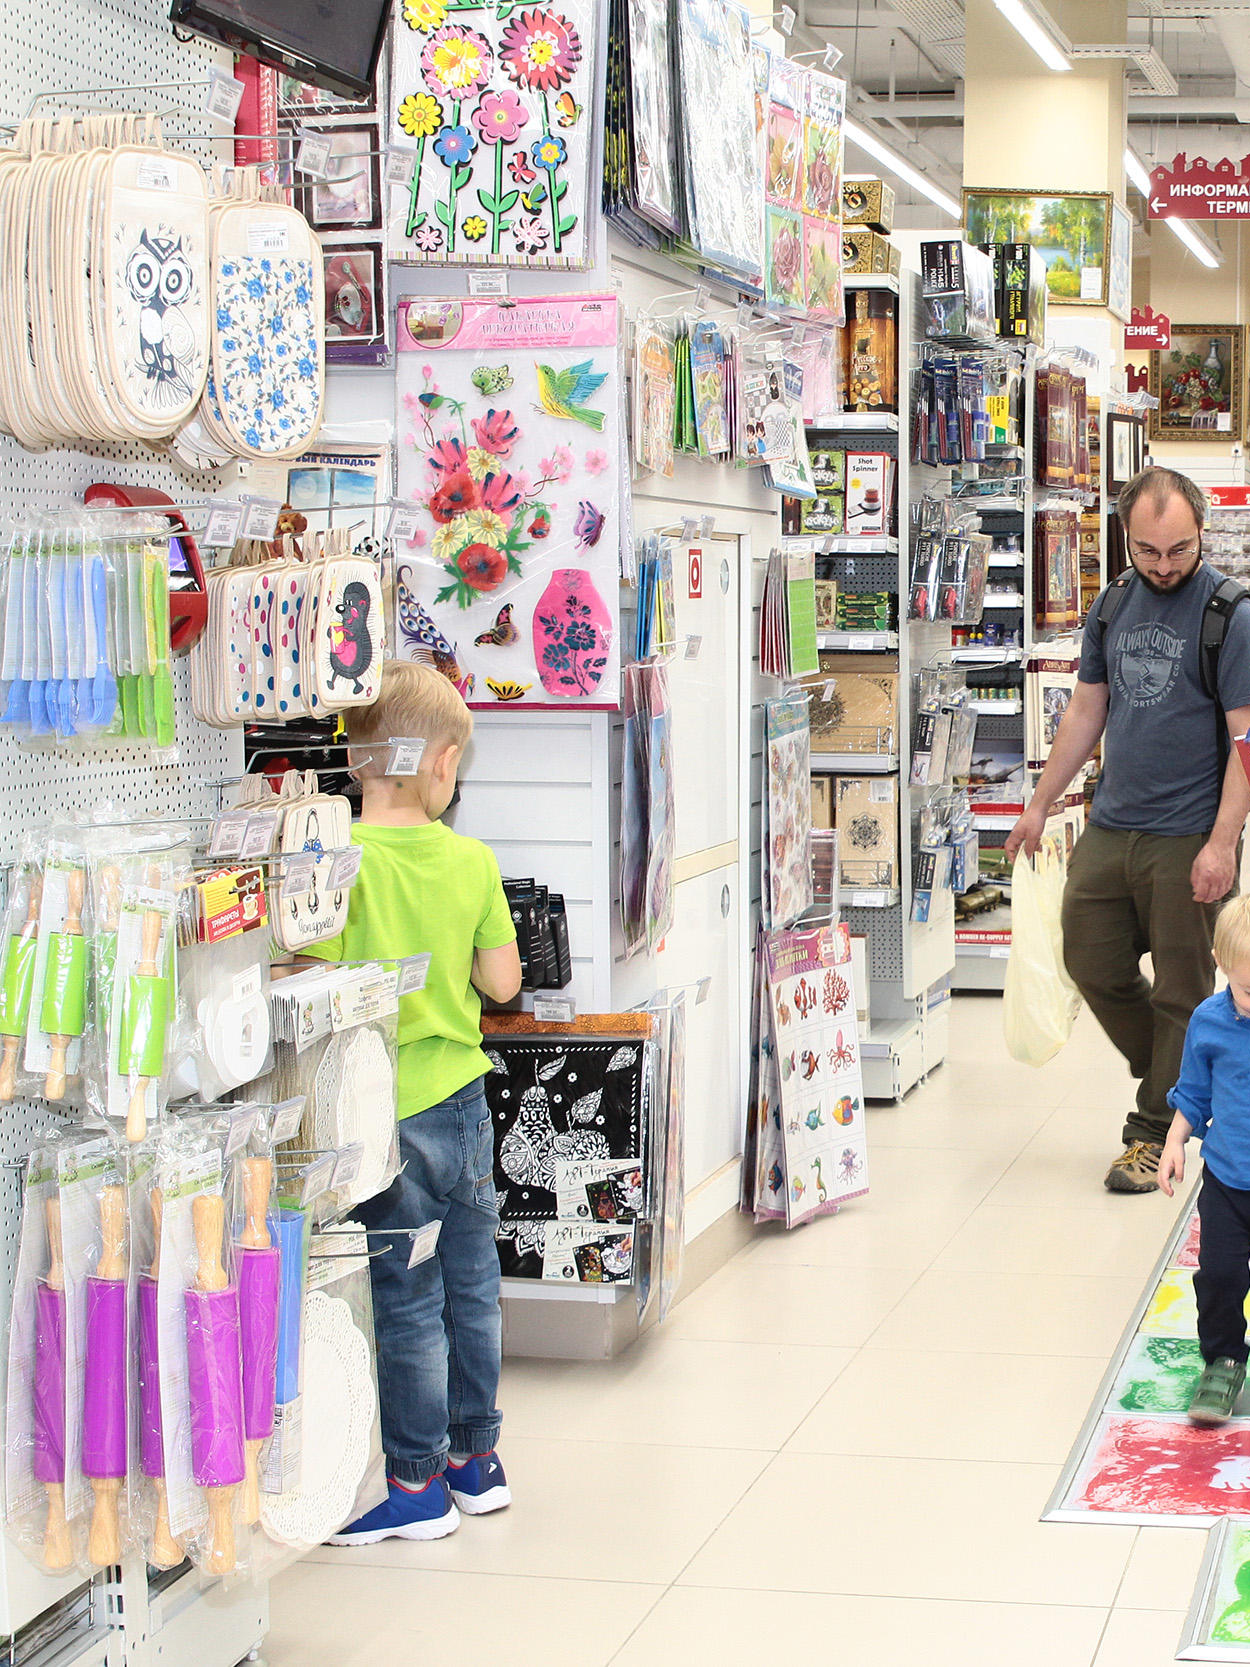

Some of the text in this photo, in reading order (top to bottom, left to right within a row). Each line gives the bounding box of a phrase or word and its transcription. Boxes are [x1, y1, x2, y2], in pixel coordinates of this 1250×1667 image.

[1124, 326, 1159, 336] ЕНИЕ
[320, 457, 376, 468] КАЛЕНДАРЬ
[1150, 628, 1186, 658] OUTSIDE
